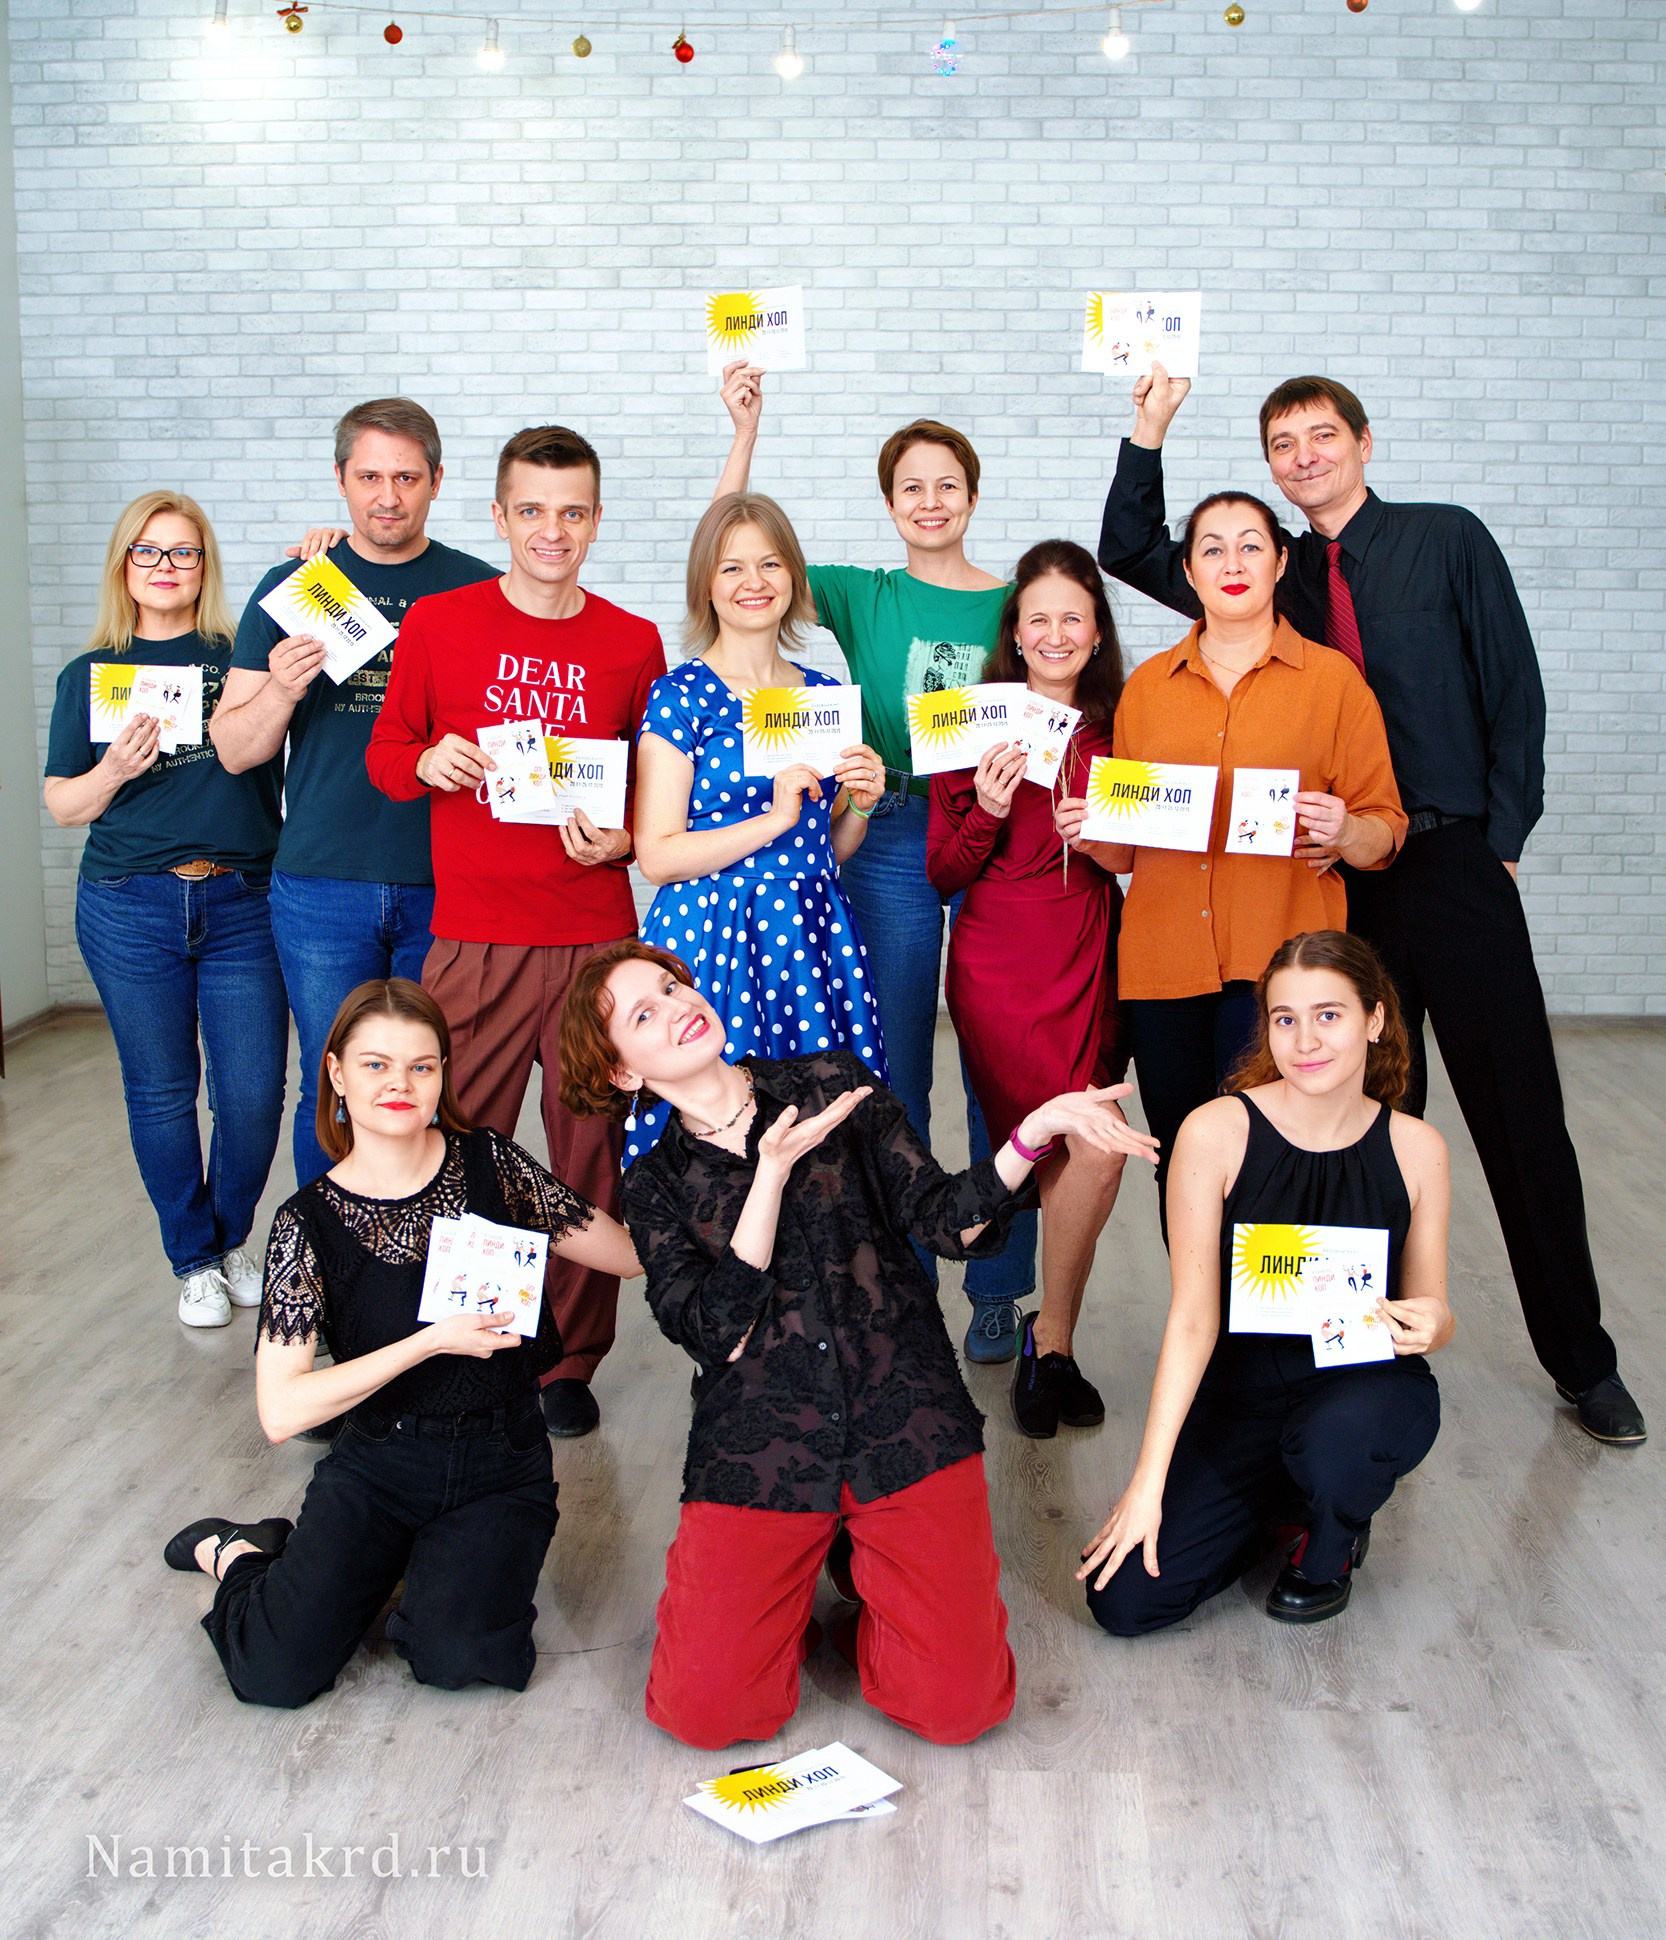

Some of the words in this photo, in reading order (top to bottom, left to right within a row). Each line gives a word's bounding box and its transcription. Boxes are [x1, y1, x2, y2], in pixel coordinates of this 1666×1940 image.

[725, 313, 764, 331] ЛИНДИ
[767, 311, 788, 327] ХОП
[1162, 316, 1181, 332] ОП
[307, 582, 348, 622] ЛИНДИ
[340, 616, 367, 642] ХОП
[496, 653, 586, 691] DEAR
[484, 685, 588, 724] SANTA
[764, 711, 810, 729] ЛИНДИ
[815, 710, 840, 726] ХОП
[931, 707, 977, 729] ЛИНДИ
[981, 705, 1007, 720] ХОП
[165, 748, 215, 768] AUTHENTIC
[577, 763, 604, 780] ХОП
[1110, 782, 1160, 802] ЛИНДИ
[1164, 788, 1192, 804] ХОП
[1260, 1255, 1319, 1277] ЛИНД
[742, 1778, 804, 1801] ЛИНДИ
[802, 1766, 839, 1784] ХОП
